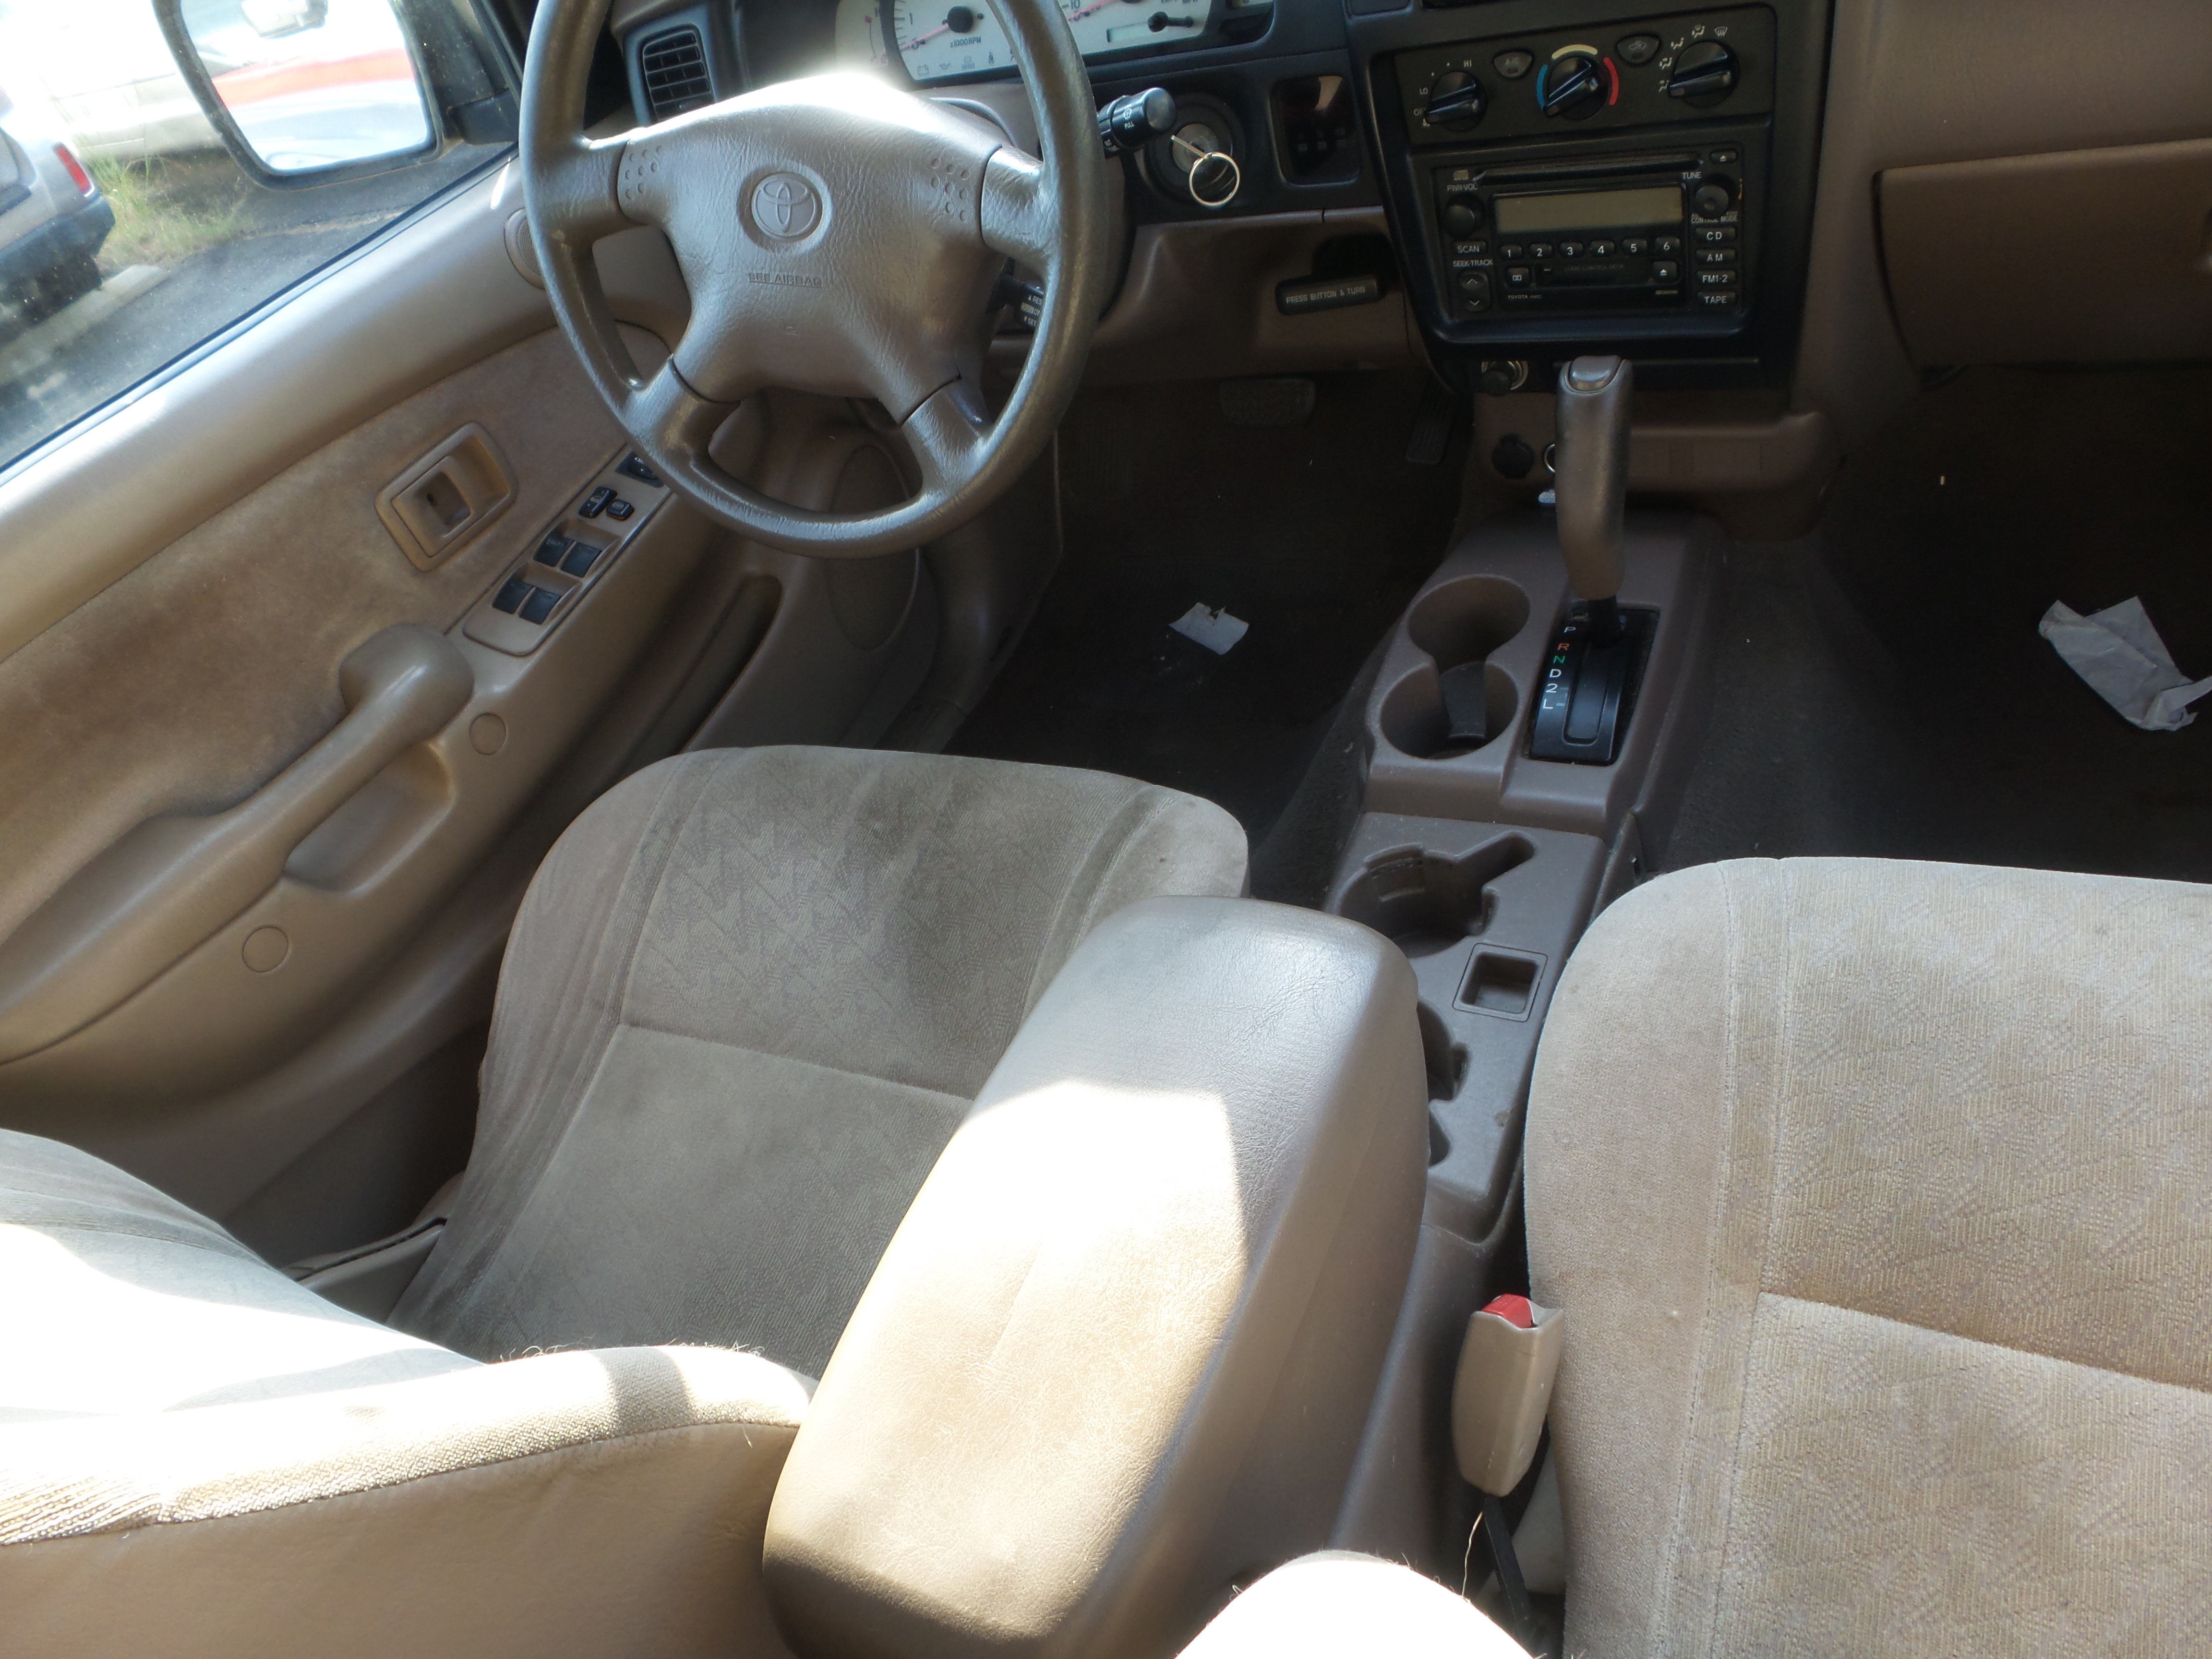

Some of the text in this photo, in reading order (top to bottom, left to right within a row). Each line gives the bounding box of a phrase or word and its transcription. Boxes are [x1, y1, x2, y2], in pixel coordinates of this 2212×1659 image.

[1682, 171, 1702, 180] TUNE
[1457, 245, 1480, 253] SCAN
[1597, 245, 1605, 254] 4
[1631, 243, 1638, 253] 5
[1663, 241, 1670, 251] 6
[1507, 249, 1512, 257] 1
[1536, 248, 1543, 257] 2
[1567, 246, 1574, 256] 3
[1286, 294, 1308, 304] PRESS
[1310, 290, 1336, 301] BUTTON
[1347, 286, 1365, 295] TURN
[1704, 295, 1727, 304] TAPE
[1033, 296, 1042, 305] RES
[1028, 318, 1036, 326] SET
[1553, 655, 1566, 663] N
[1550, 669, 1562, 678] D
[1546, 683, 1558, 693] 2
[1543, 699, 1553, 709] L
